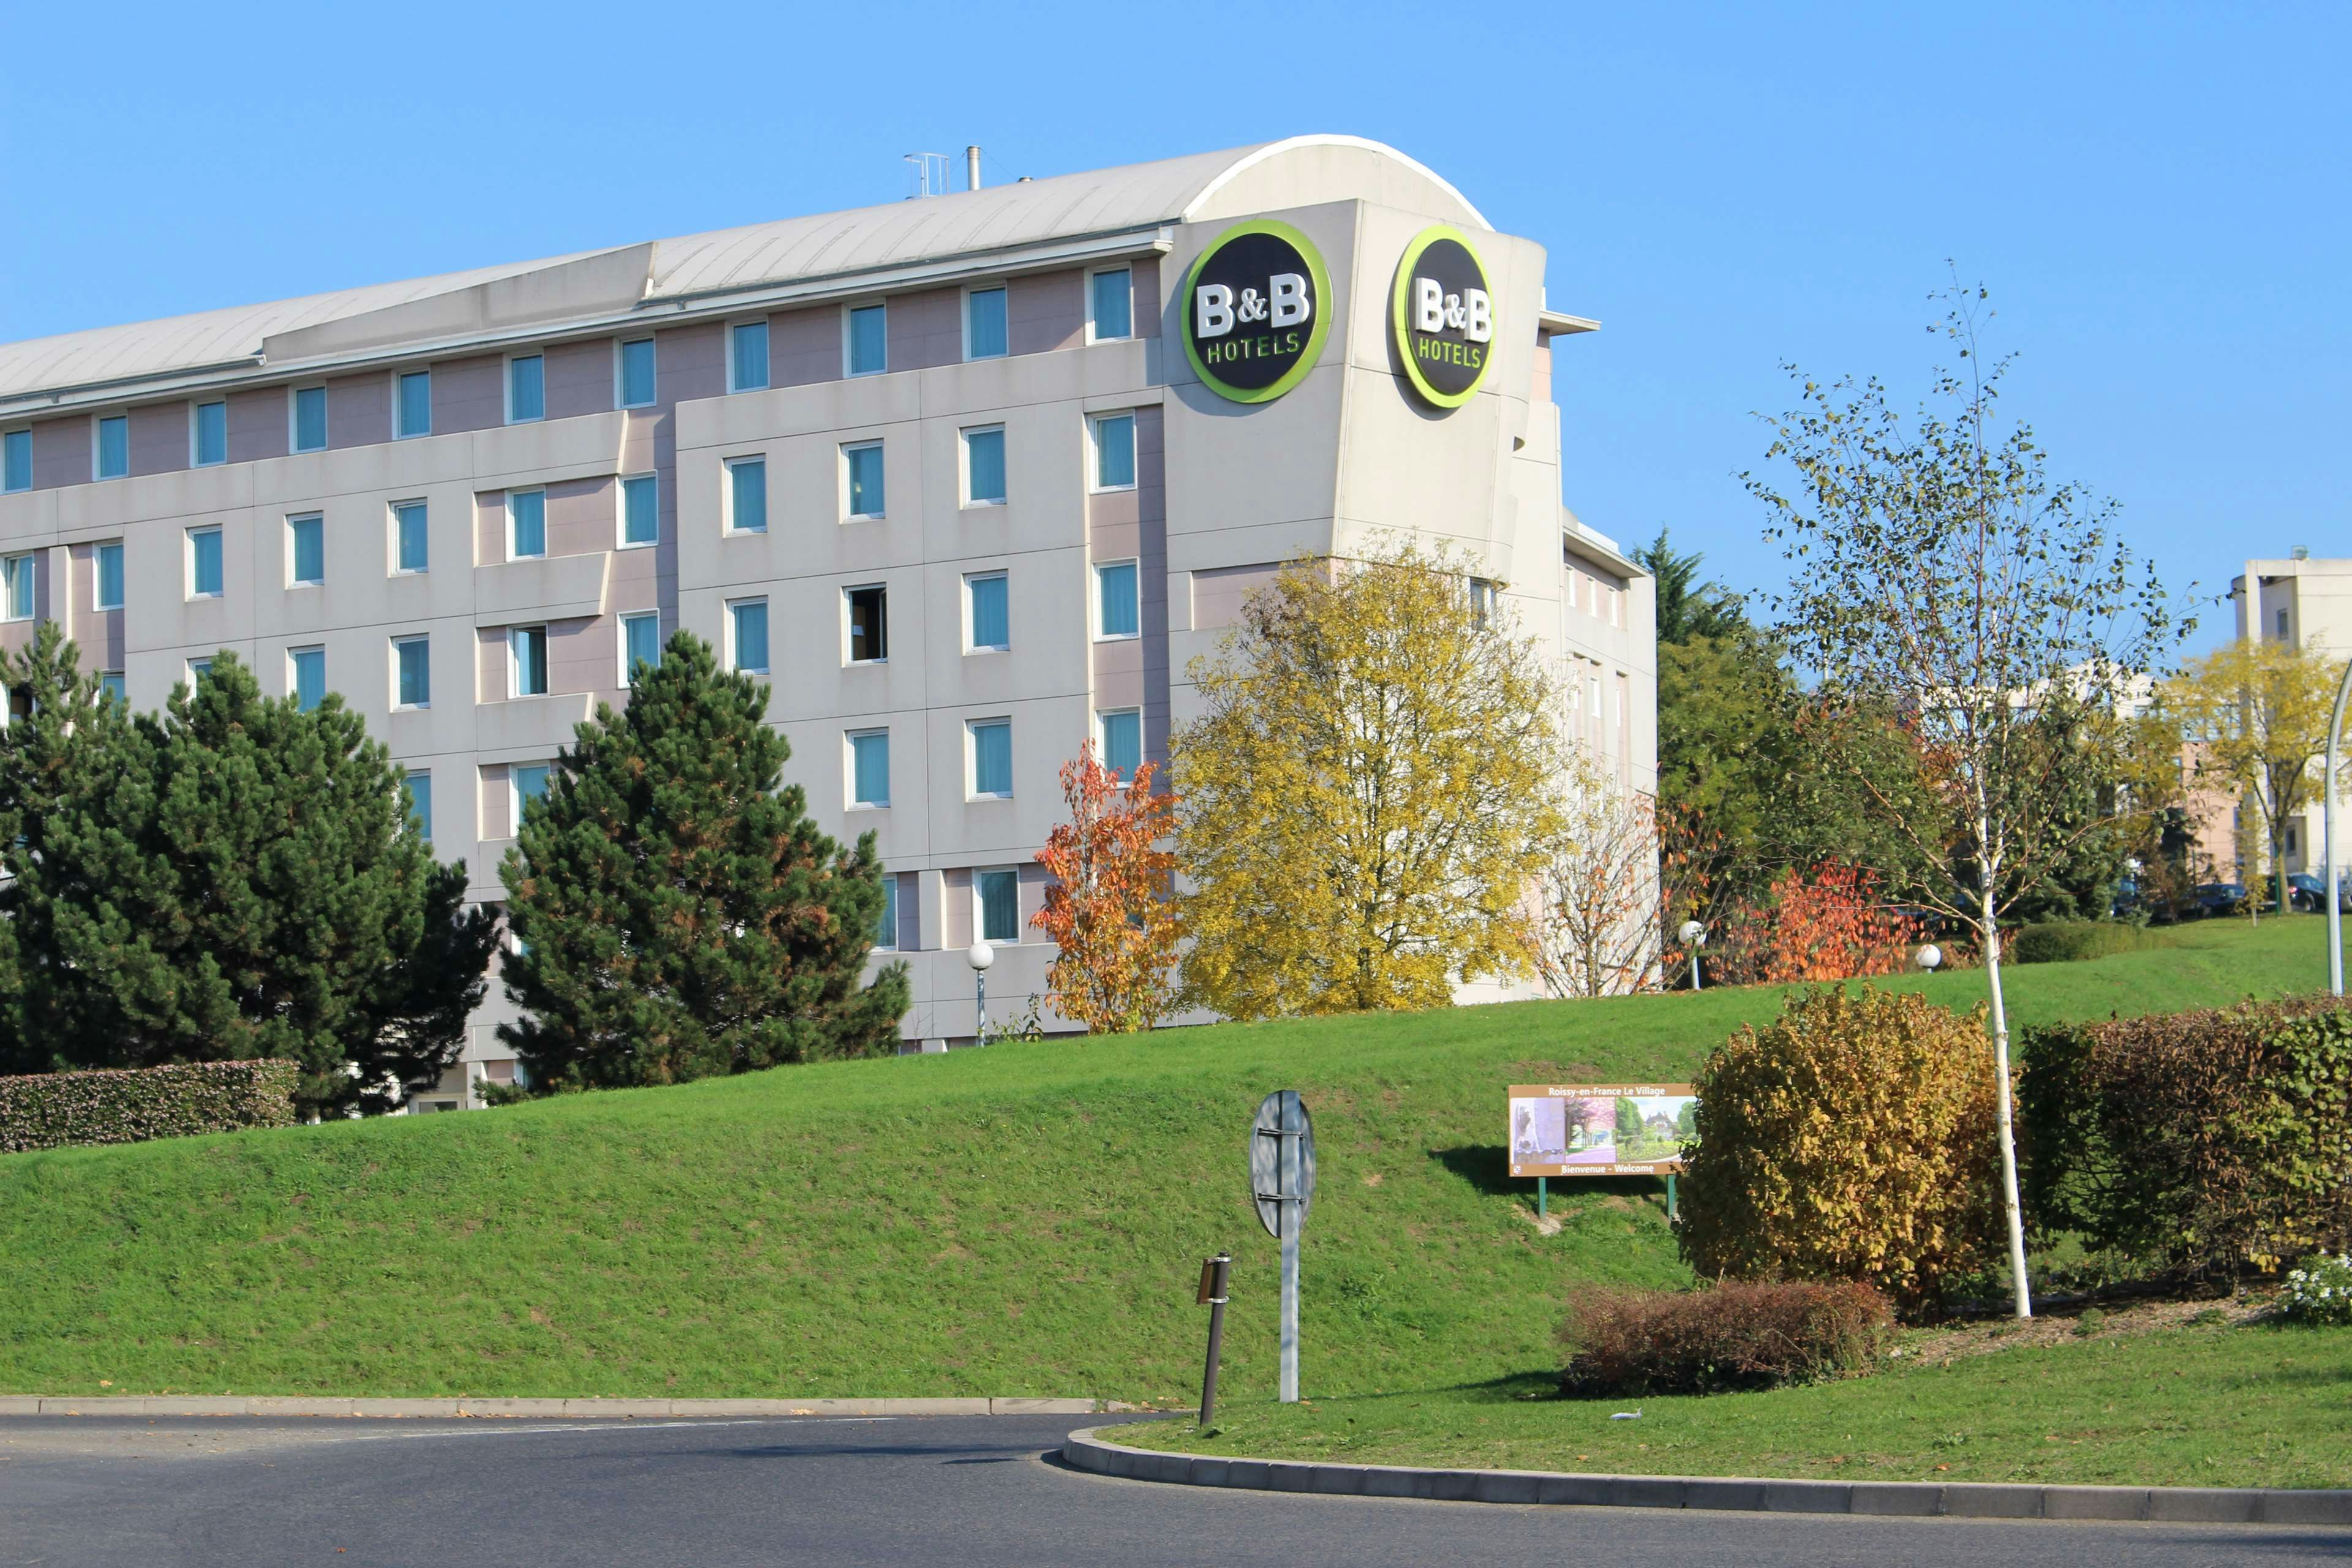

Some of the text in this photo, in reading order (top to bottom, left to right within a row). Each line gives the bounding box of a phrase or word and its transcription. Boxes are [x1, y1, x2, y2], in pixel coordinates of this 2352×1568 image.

[1197, 273, 1310, 338] B&B
[1416, 277, 1493, 343] B&B
[1207, 333, 1300, 364] HOTELS
[1419, 339, 1481, 369] HOTELS
[1548, 1087, 1621, 1097] Roissy-en-France
[1636, 1087, 1665, 1096] Village
[1561, 1165, 1605, 1174] Bienvenue
[1615, 1164, 1654, 1173] Welcome
